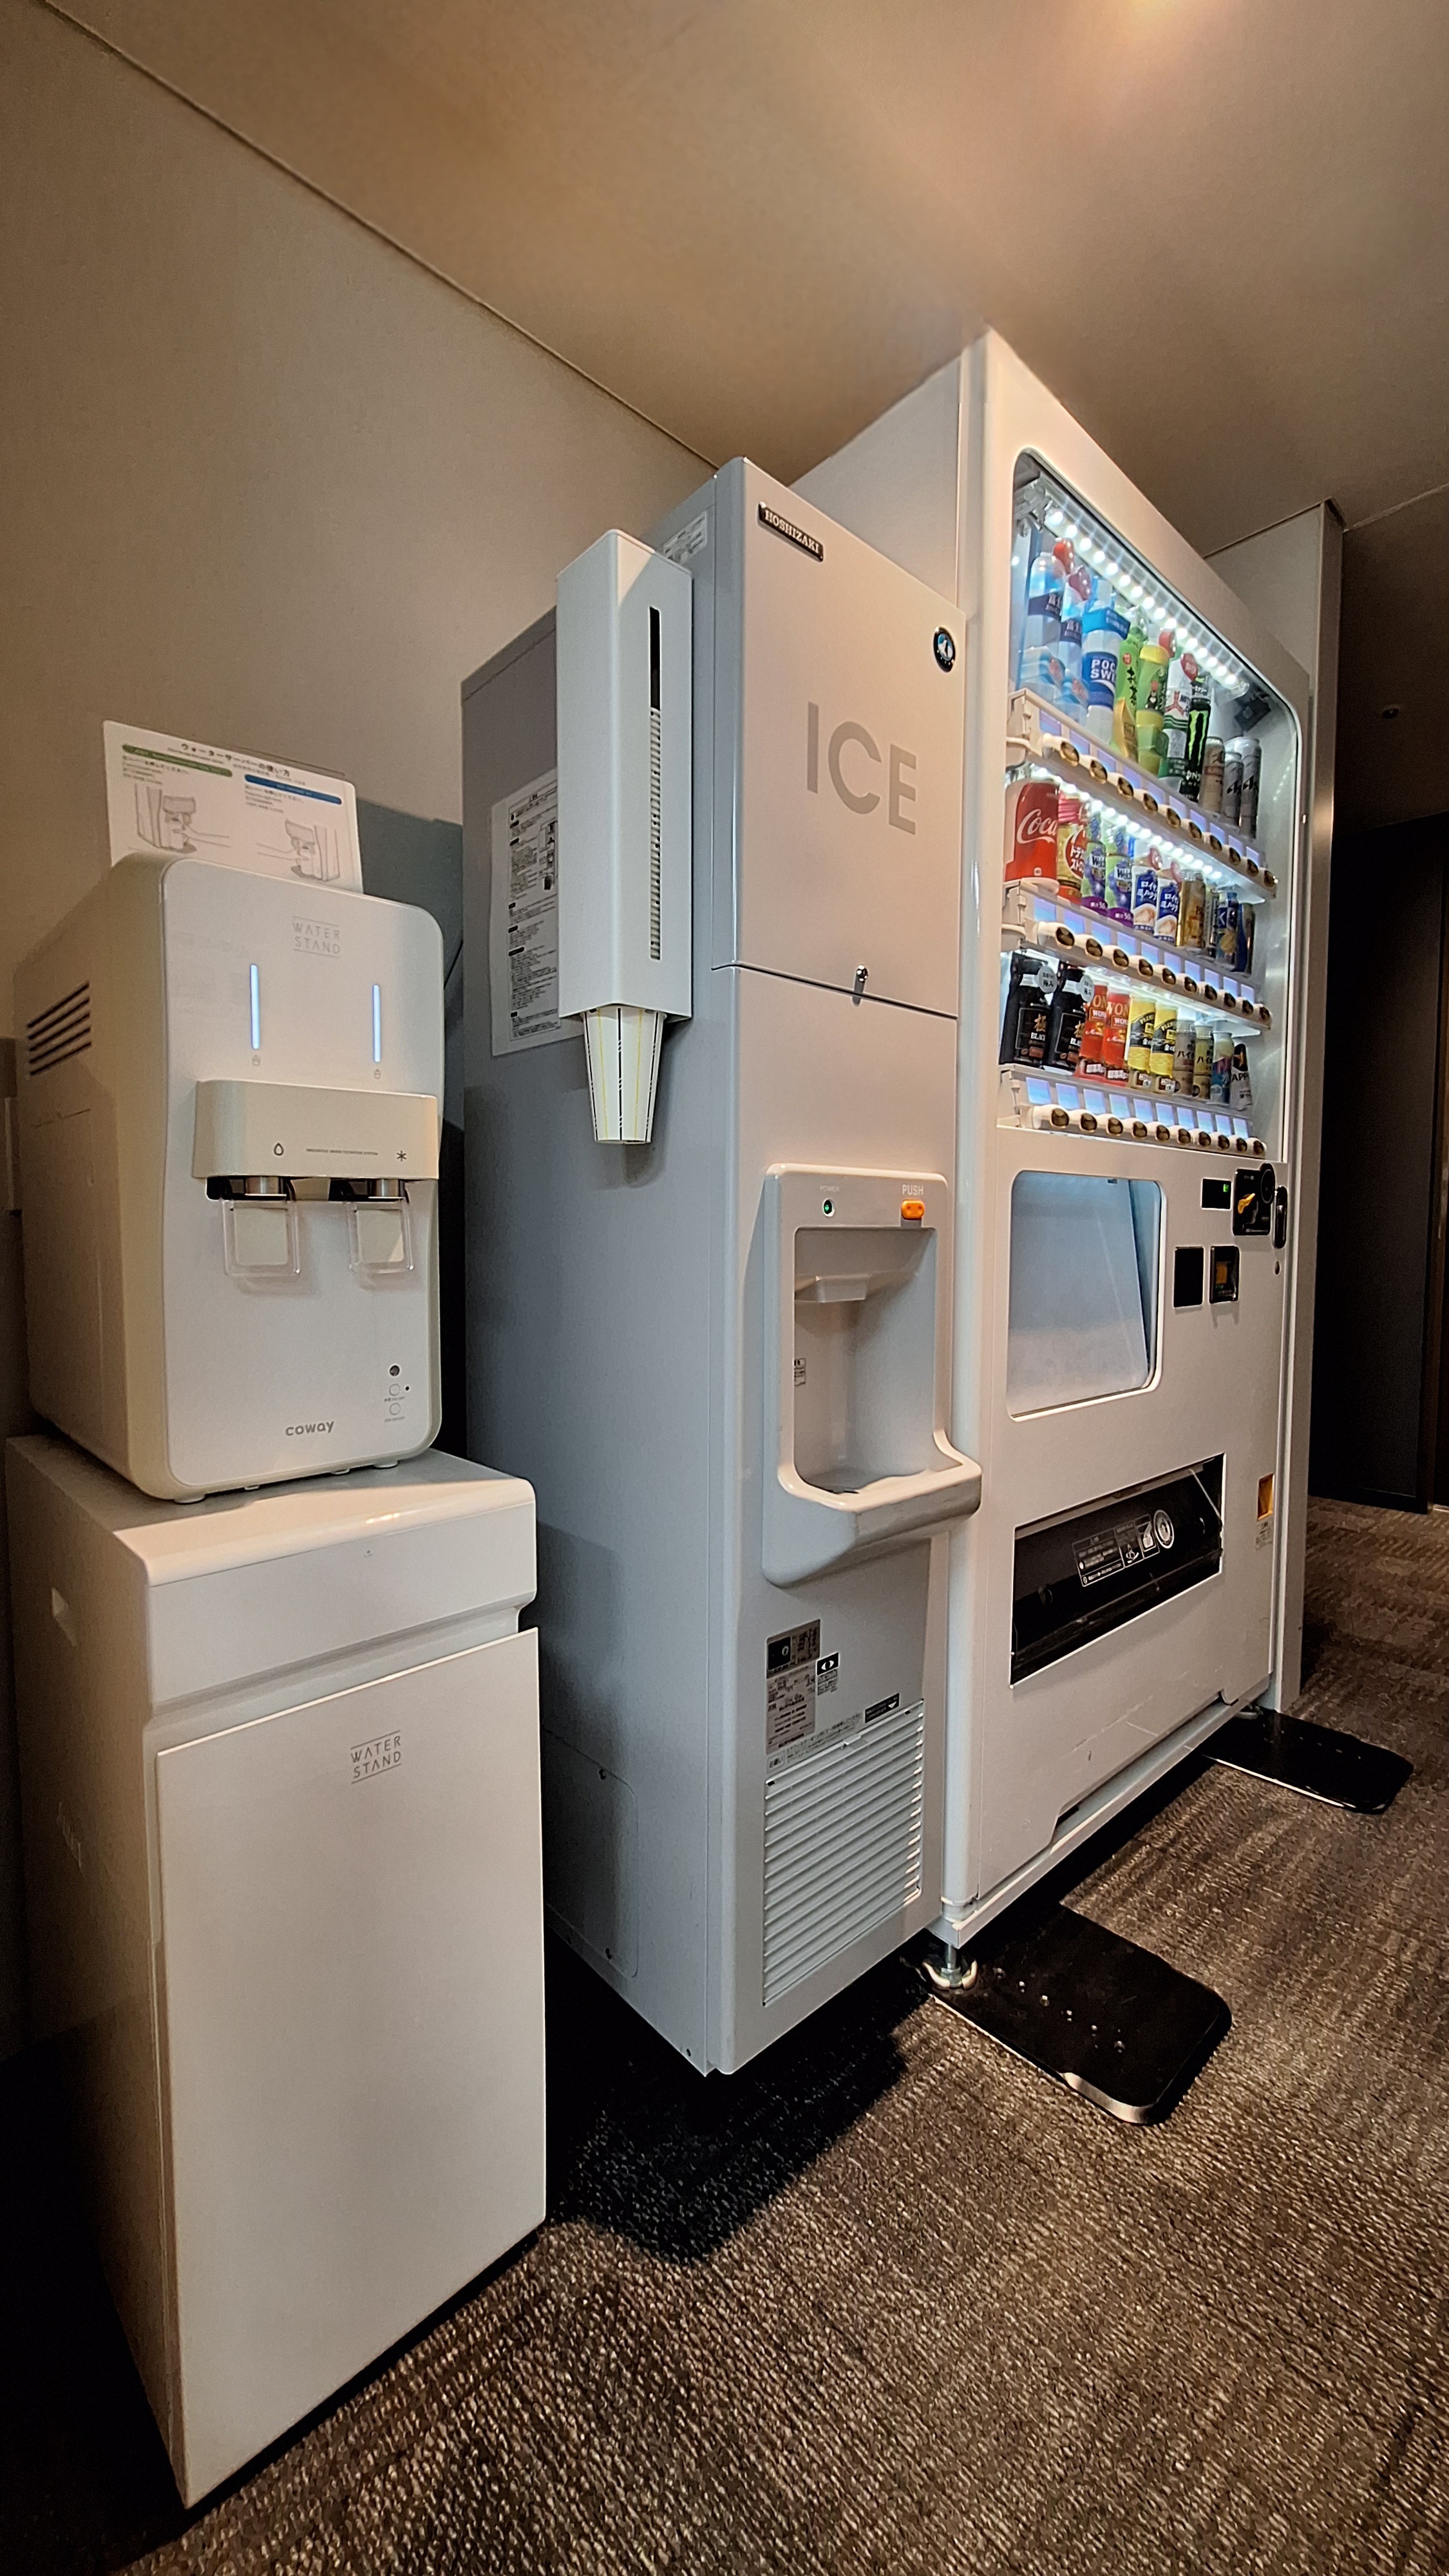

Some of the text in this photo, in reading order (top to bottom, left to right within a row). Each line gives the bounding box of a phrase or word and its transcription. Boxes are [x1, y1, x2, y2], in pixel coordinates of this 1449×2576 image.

[764, 509, 820, 554] HOSHIZAKI
[807, 701, 917, 836] ICE
[292, 922, 340, 941] WATER
[294, 935, 341, 955] STAND
[902, 1184, 924, 1196] PUSH
[285, 1421, 334, 1437] coway
[350, 1735, 401, 1763] WATER
[353, 1751, 401, 1779] STAND
